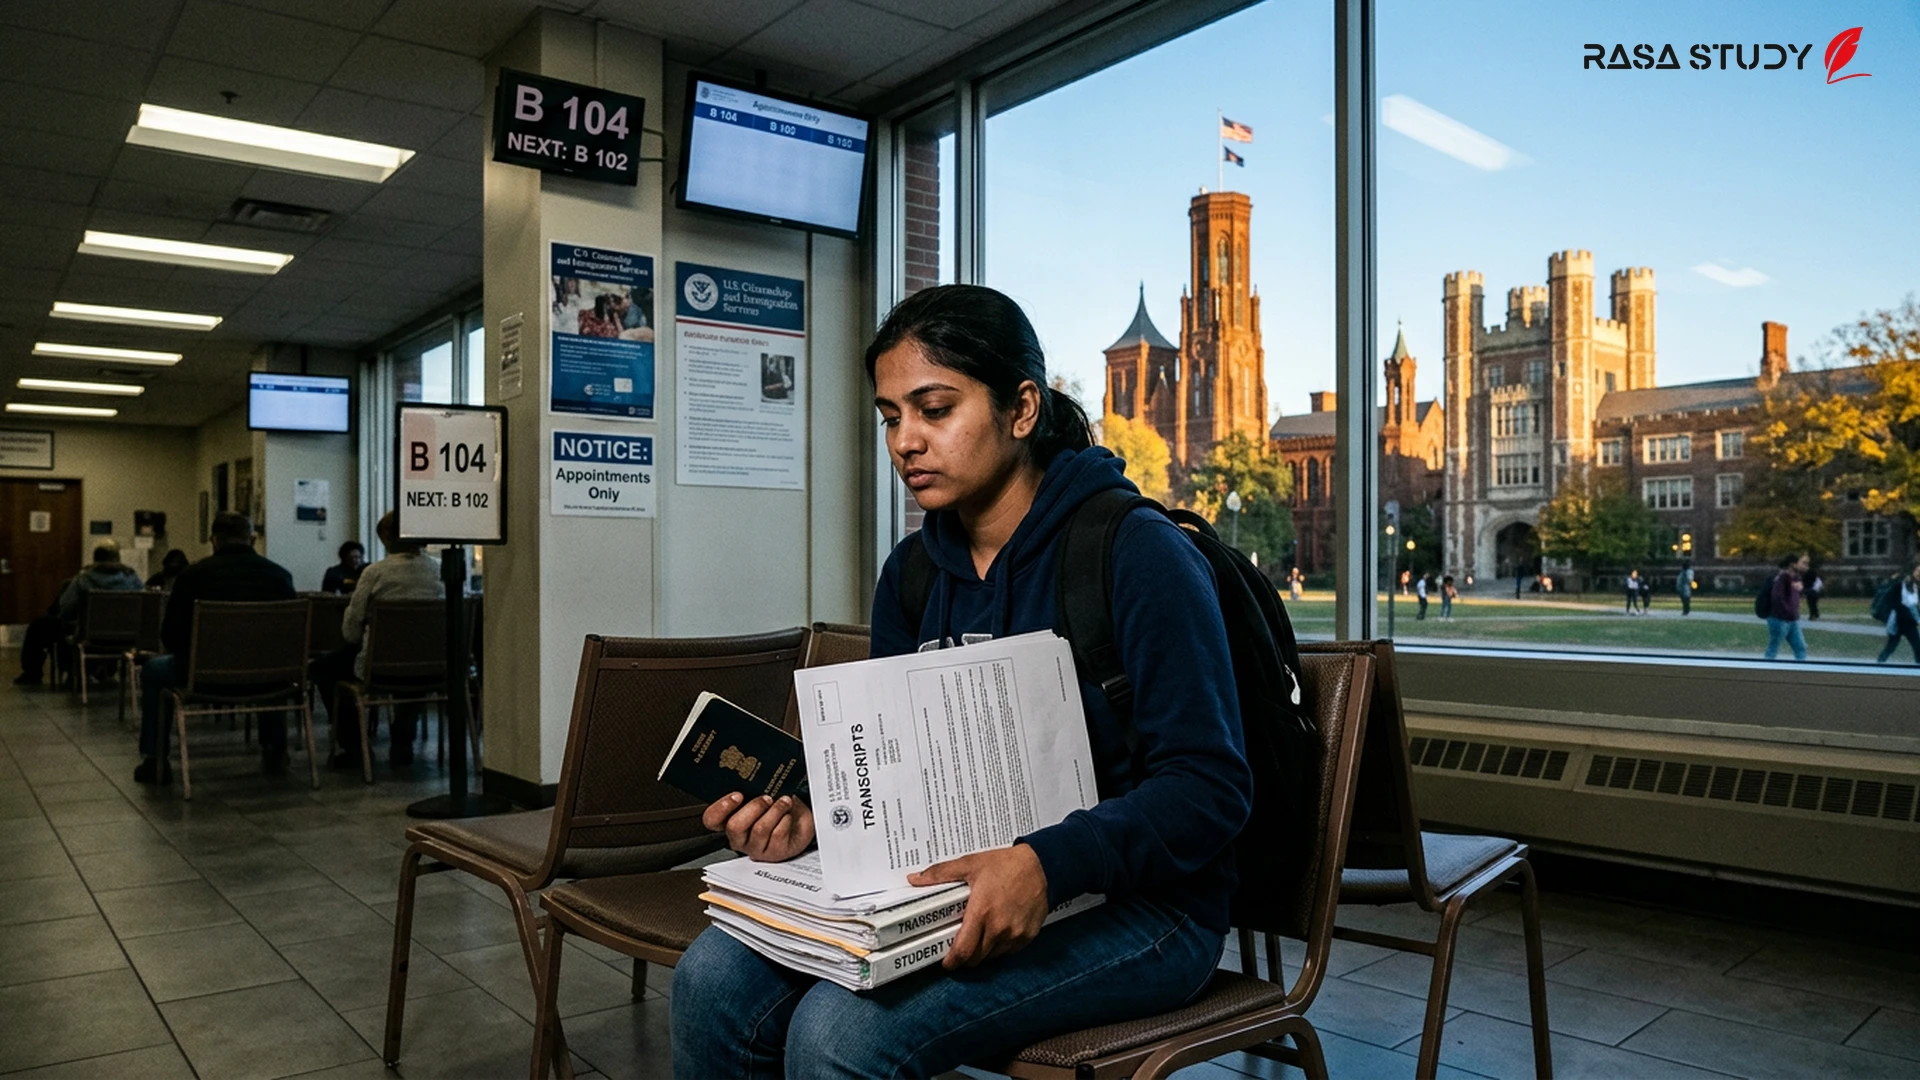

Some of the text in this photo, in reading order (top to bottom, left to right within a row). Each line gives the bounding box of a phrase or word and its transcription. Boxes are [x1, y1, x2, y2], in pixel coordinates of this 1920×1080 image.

[515, 84, 629, 140] B 104
[507, 131, 628, 171] NEXT: B 102
[411, 441, 487, 473] B 104
[560, 437, 648, 461] NOTICE:
[556, 467, 651, 485] Appointments
[406, 491, 489, 508] NEXT: B 102
[850, 723, 876, 830] TRANSCRIPTS
